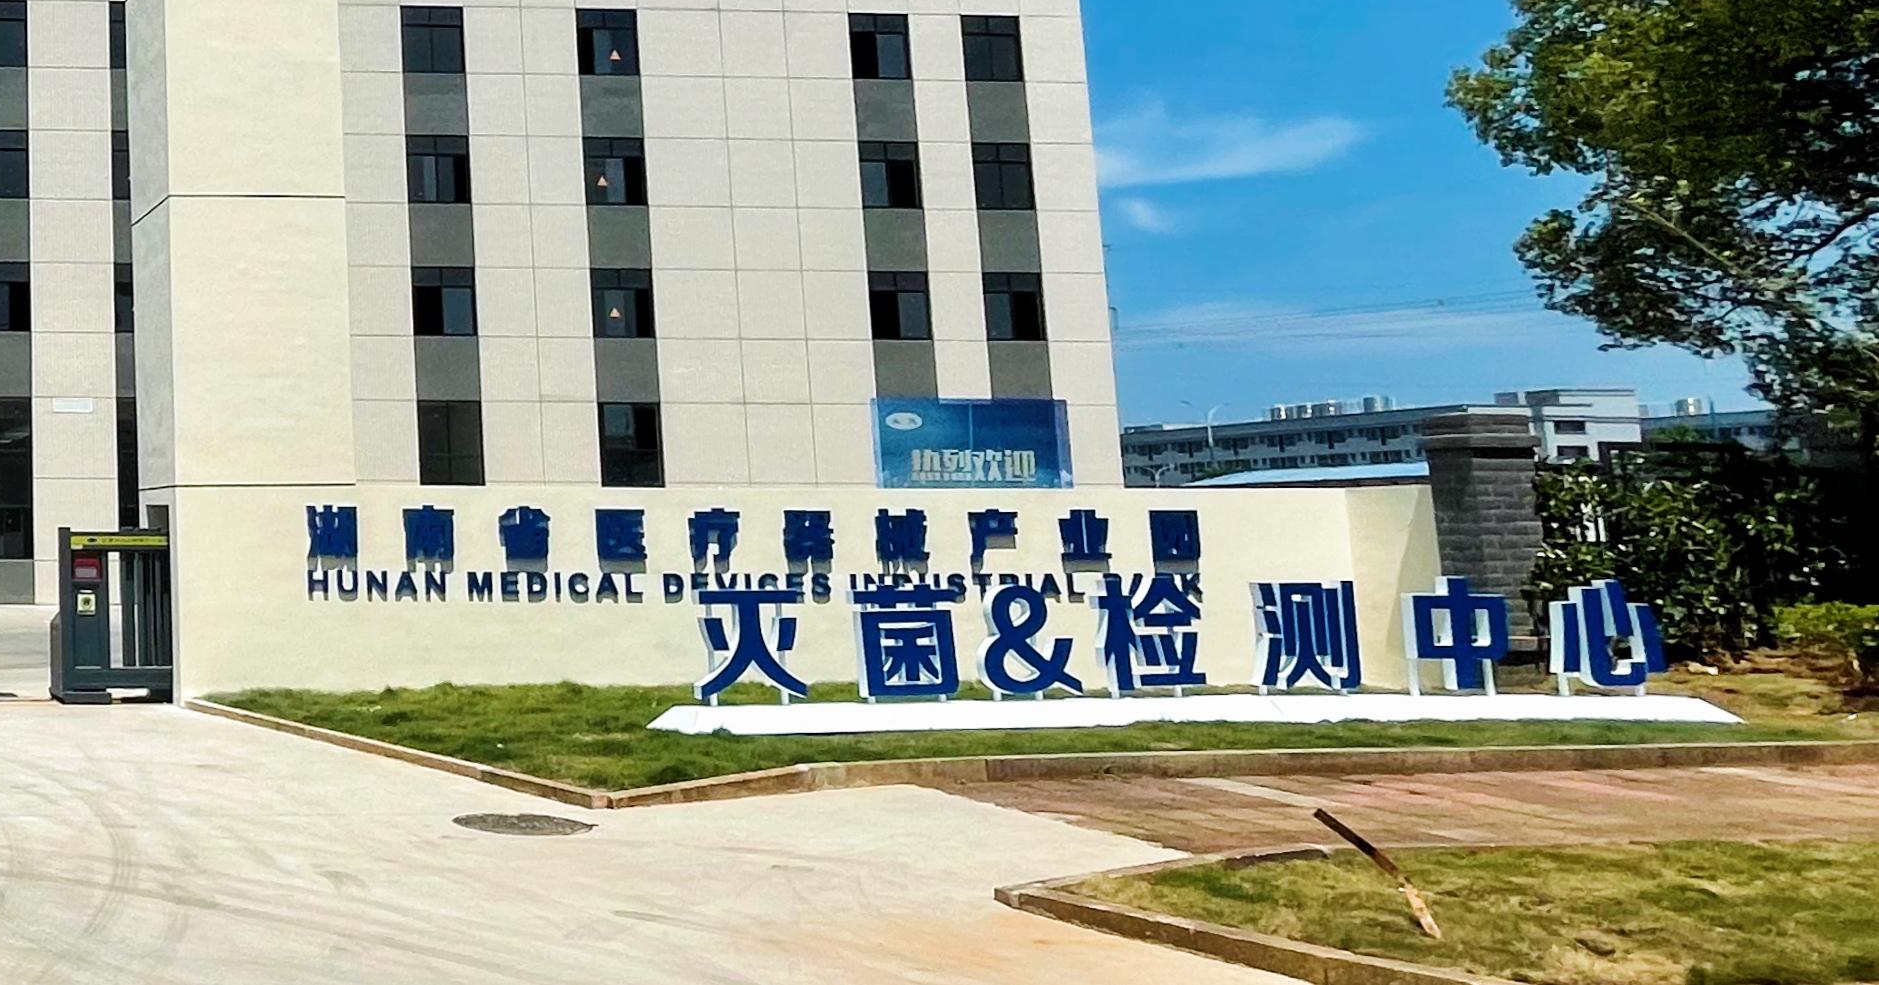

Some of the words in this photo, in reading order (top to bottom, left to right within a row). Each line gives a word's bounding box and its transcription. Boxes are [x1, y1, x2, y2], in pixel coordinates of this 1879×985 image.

[910, 449, 1036, 481] 热烈欢迎
[306, 505, 1201, 572] 湖南省医疗器械产业园
[307, 571, 447, 602] HUNAN
[467, 572, 644, 604] MEDICAL
[663, 573, 832, 604] DEVICES
